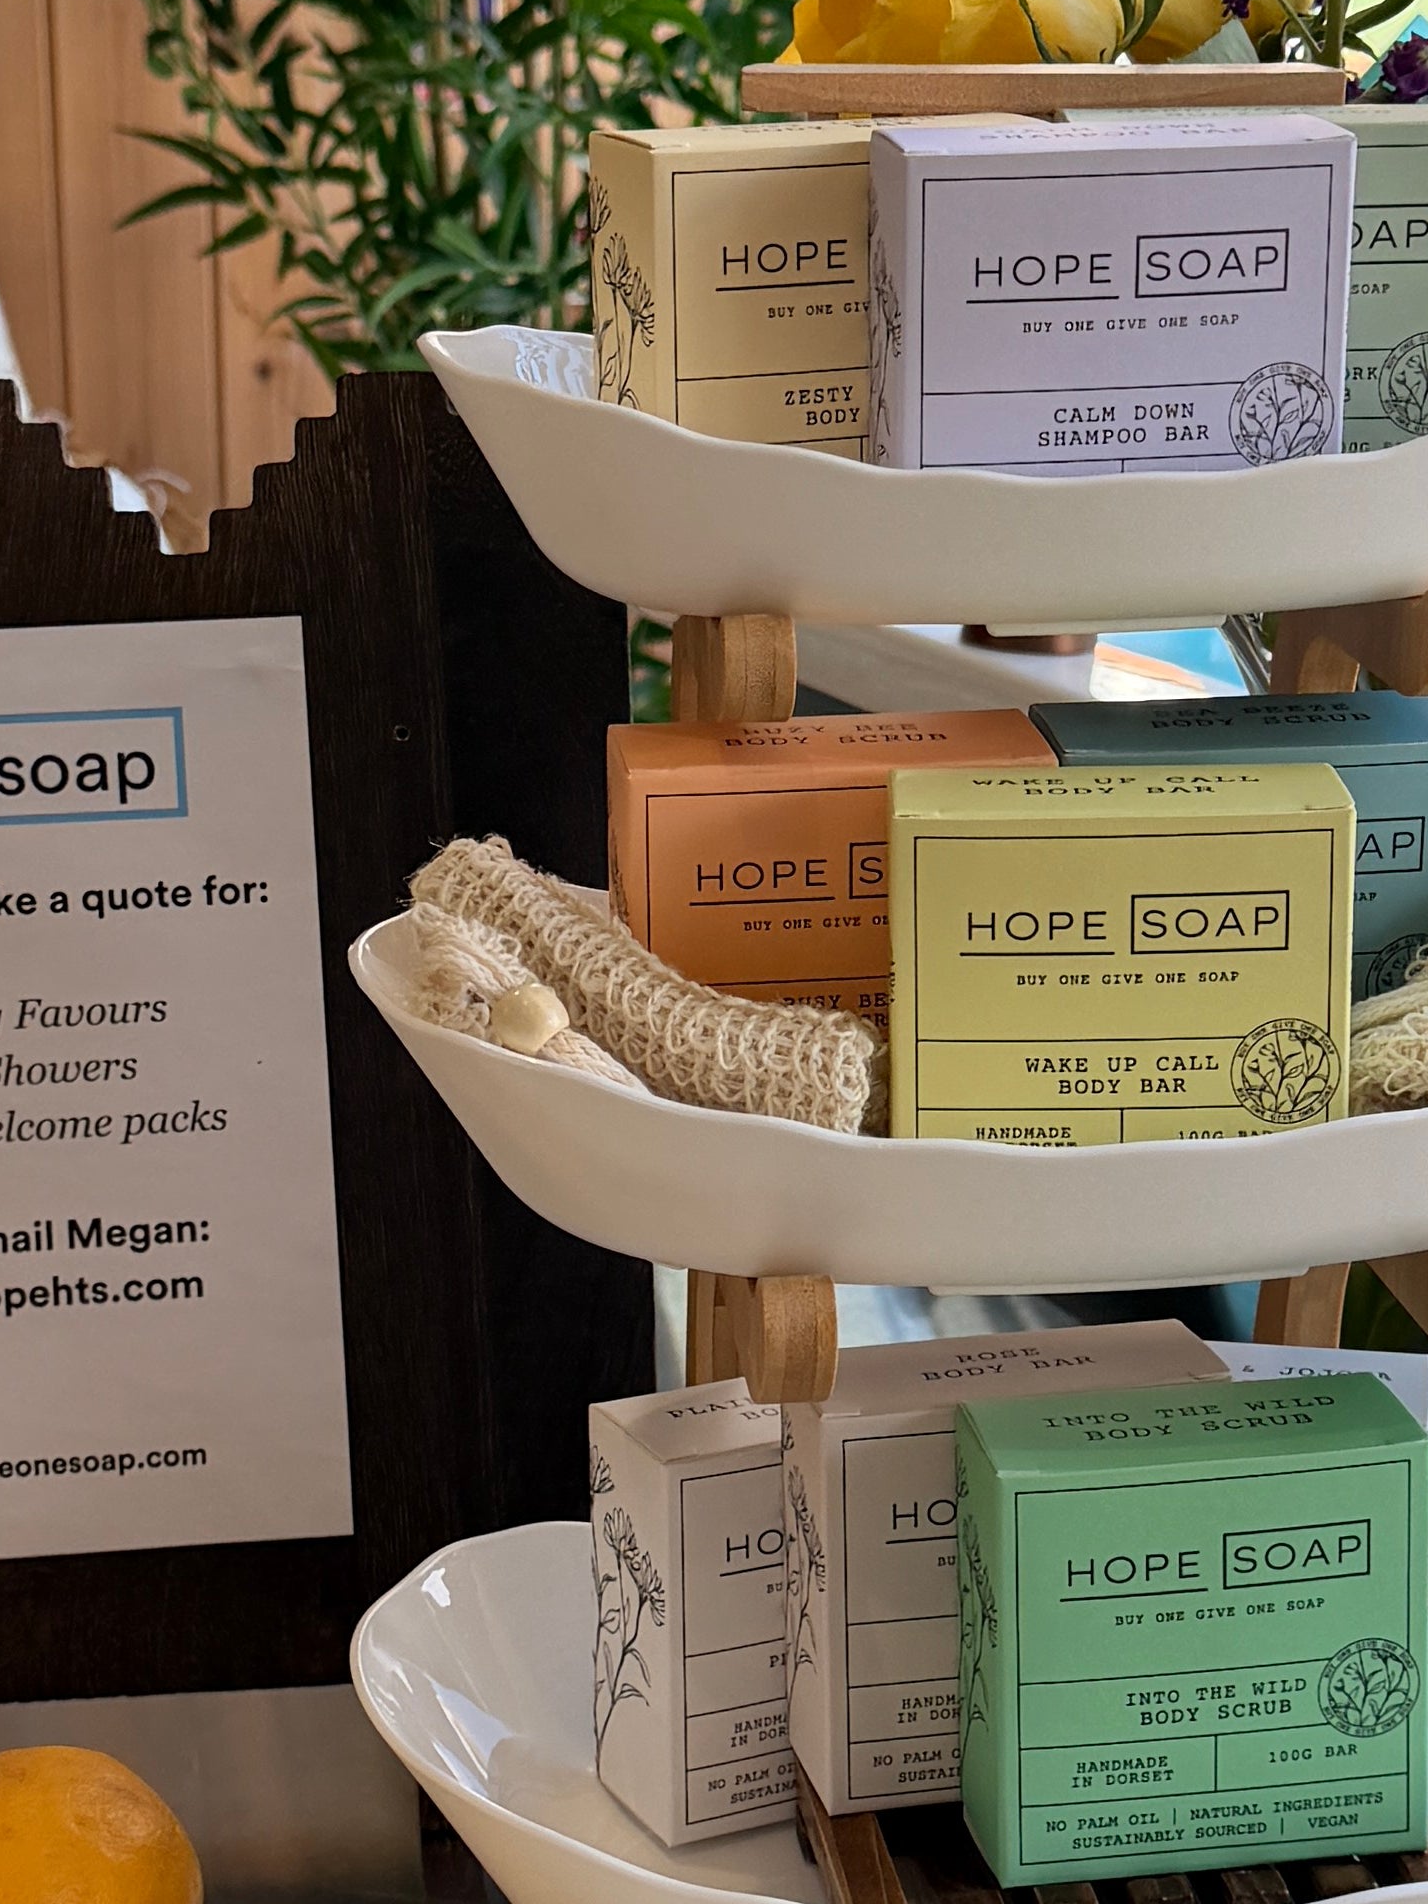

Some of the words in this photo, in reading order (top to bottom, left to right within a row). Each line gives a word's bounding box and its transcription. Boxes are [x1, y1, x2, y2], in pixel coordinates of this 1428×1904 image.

[723, 239, 847, 275] HOPE
[973, 252, 1113, 290] HOPE
[1145, 243, 1281, 282] SOAP
[768, 307, 796, 318] BUY
[806, 304, 833, 316] ONE
[1022, 319, 1053, 334] BUY
[1064, 317, 1094, 333] ONE
[1105, 316, 1148, 331] GIVE
[1158, 314, 1189, 330] ONE
[1199, 312, 1241, 327] SOAP
[785, 386, 854, 405] ZESTY
[806, 408, 861, 425] BODY
[1052, 405, 1117, 424] CALM
[1131, 401, 1196, 422] DOWN
[1038, 426, 1147, 448] SHAMPOO
[1165, 422, 1210, 443] BAR
[1150, 717, 1234, 729] BODY
[1264, 712, 1372, 725] SCRUB
[724, 736, 810, 746] BODY
[838, 733, 948, 744] SCRUB
[1025, 787, 1115, 795] BODY
[1147, 786, 1215, 794] BAR
[697, 859, 827, 892] HOPE
[49, 888, 69, 913] a
[81, 879, 192, 920] quote
[202, 875, 270, 909] for:
[744, 921, 772, 931] BUY
[783, 919, 812, 930] ONE
[823, 916, 861, 928] GIVE
[967, 910, 1108, 942] HOPE
[1141, 905, 1280, 940] SOAP
[1016, 973, 1049, 987] BUY
[1059, 973, 1091, 986] ONE
[1101, 972, 1145, 985] GIVE
[1156, 971, 1189, 985] ONE
[1199, 970, 1240, 984] SOAP
[15, 996, 167, 1033] Favours
[1024, 1056, 1089, 1075] WAKE
[1106, 1055, 1138, 1074] UP
[1156, 1054, 1220, 1073] CALL
[1057, 1077, 1124, 1095] BODY
[1140, 1076, 1188, 1094] BAR
[121, 1100, 229, 1145] packs
[976, 1127, 1072, 1140] HANDMADE
[67, 1213, 211, 1255] Megan:
[920, 1362, 1008, 1383] BODY
[1031, 1351, 1097, 1372] BAR
[955, 1345, 1041, 1366] ROSE
[1042, 1412, 1130, 1428] INTO
[1155, 1405, 1222, 1419] THE
[1245, 1395, 1336, 1412] WILD
[1084, 1424, 1172, 1442] BODY
[1201, 1413, 1314, 1431] SCRUB
[1068, 1550, 1201, 1587] HOPE
[1233, 1535, 1363, 1574] SOAP
[1115, 1614, 1144, 1626] BUY
[1156, 1610, 1185, 1623] ONE
[1196, 1606, 1236, 1620] GIVE
[1246, 1602, 1275, 1616] ONE
[1286, 1598, 1325, 1611] SOAP
[1125, 1690, 1180, 1707] INTO
[1196, 1685, 1236, 1701] THE
[1252, 1678, 1308, 1696] WILD
[897, 1712, 917, 1724] IN
[1140, 1708, 1200, 1726] BODY
[1218, 1700, 1292, 1719] SCRUB
[730, 1736, 749, 1748] IN
[873, 1755, 893, 1768] NO
[903, 1748, 942, 1764] PALM
[1076, 1756, 1168, 1773] HANDMADE
[1268, 1749, 1313, 1763] 100G
[1325, 1744, 1358, 1758] BAR
[708, 1780, 726, 1792] NO
[735, 1768, 770, 1786] PALM
[1071, 1776, 1092, 1789] IN
[1106, 1770, 1175, 1786] DORSET
[1046, 1820, 1067, 1833] NO
[1077, 1816, 1118, 1830] PALM
[1129, 1812, 1159, 1826] OIL
[1190, 1805, 1262, 1821] NATURAL
[1273, 1792, 1383, 1814] INGREDIENTS
[1072, 1830, 1185, 1850] SUSTAINABLY
[1195, 1821, 1267, 1839] SOURCED
[1307, 1814, 1359, 1829] VEGAN
